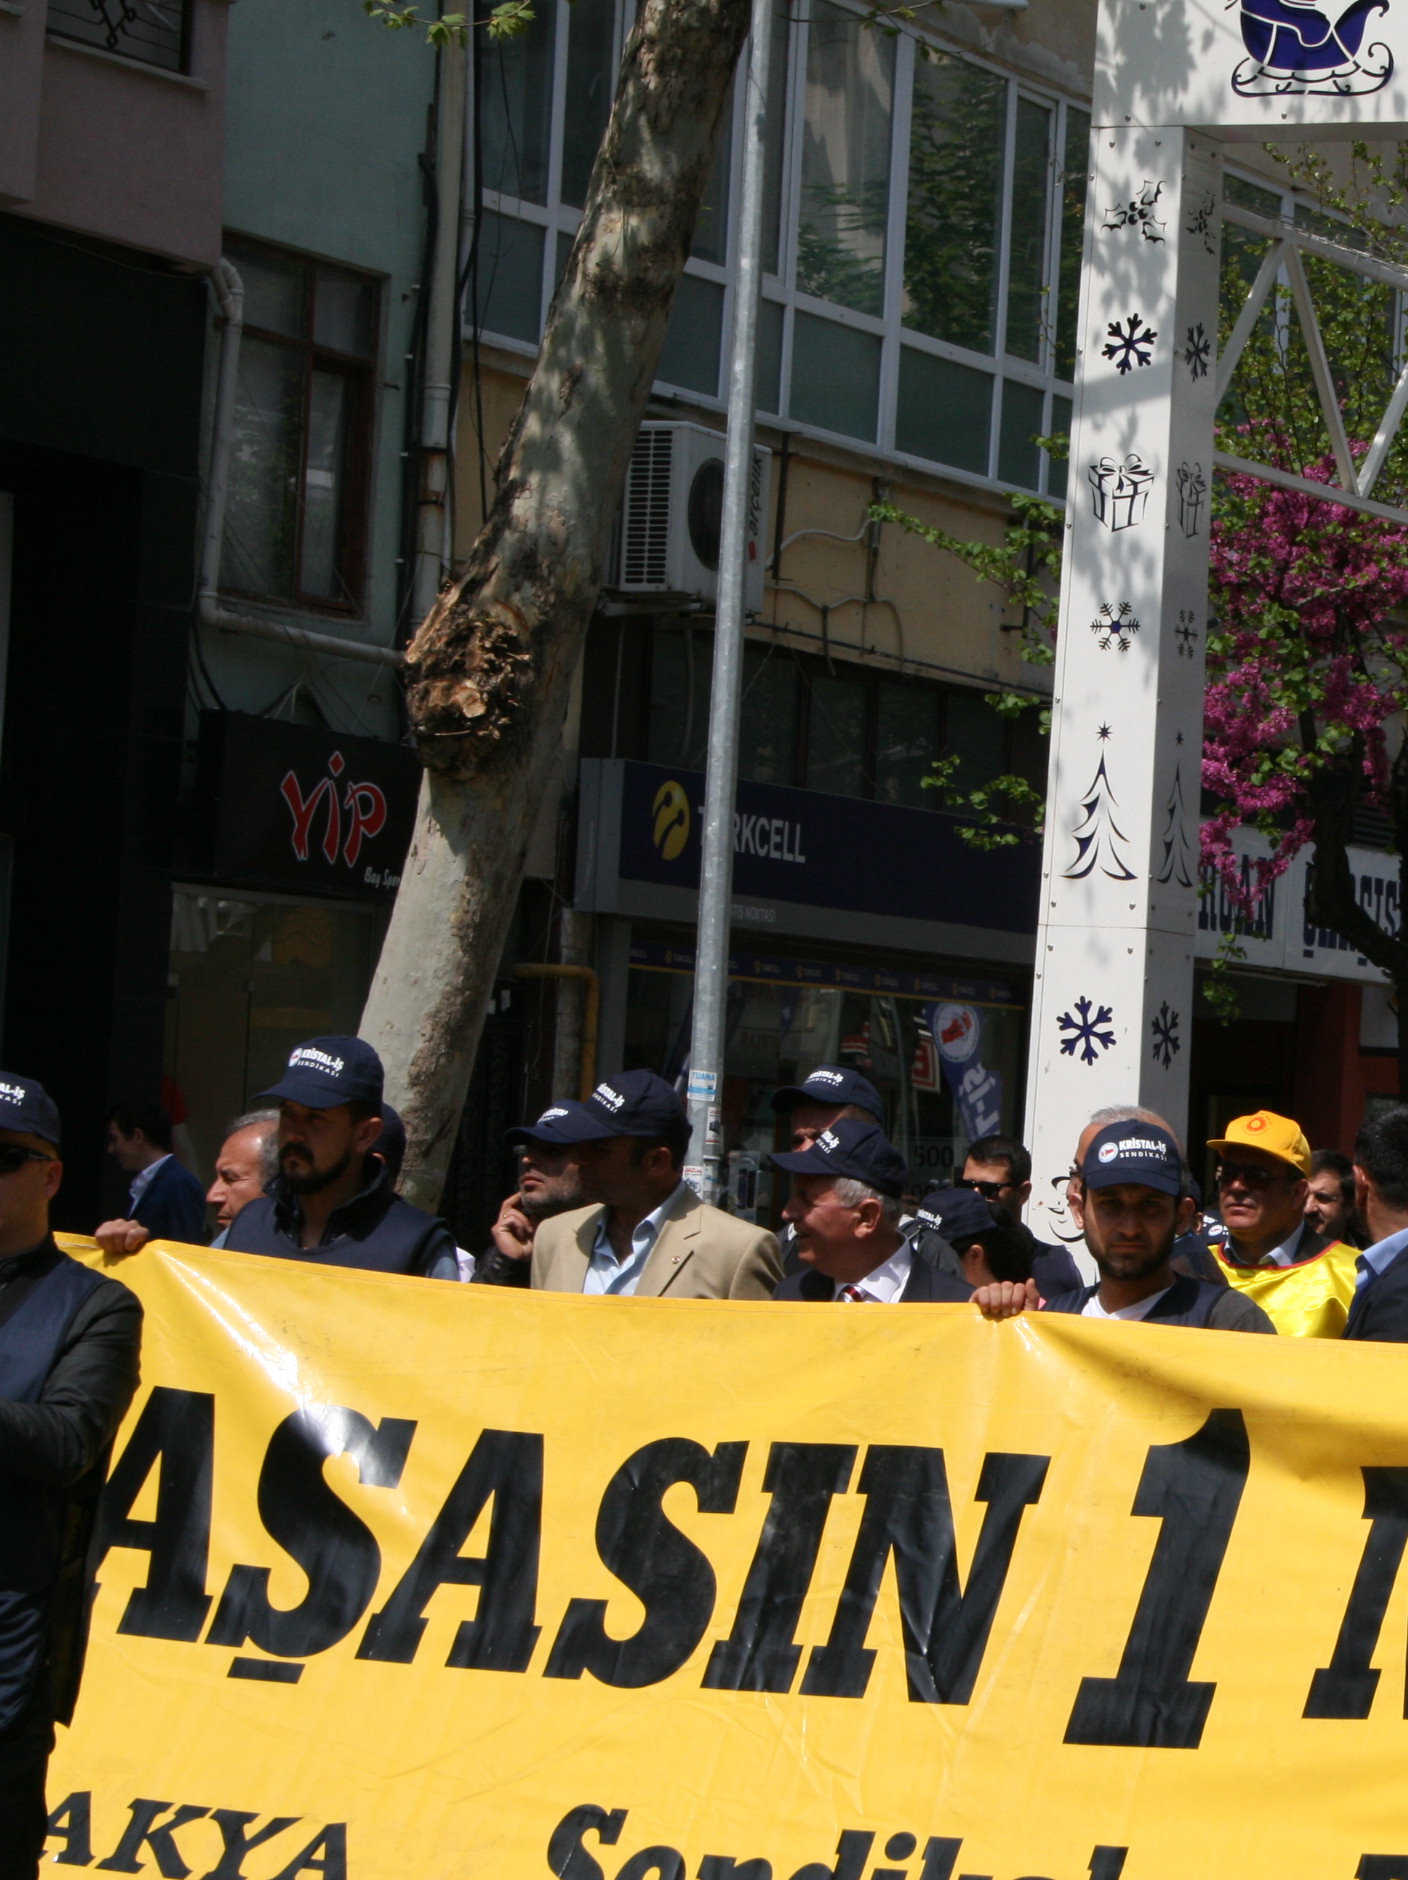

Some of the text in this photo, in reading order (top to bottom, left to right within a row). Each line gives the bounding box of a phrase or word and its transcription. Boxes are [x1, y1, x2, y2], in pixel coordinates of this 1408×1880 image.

[698, 806, 806, 863] RKCELL
[1118, 1137, 1167, 1155] KRİSTAL-İŞ
[1119, 1150, 1168, 1162] SENDİKASI
[93, 1386, 1051, 1706] AŞASIN
[1063, 1409, 1251, 1749] 1
[38, 1791, 347, 1880] AKYA
